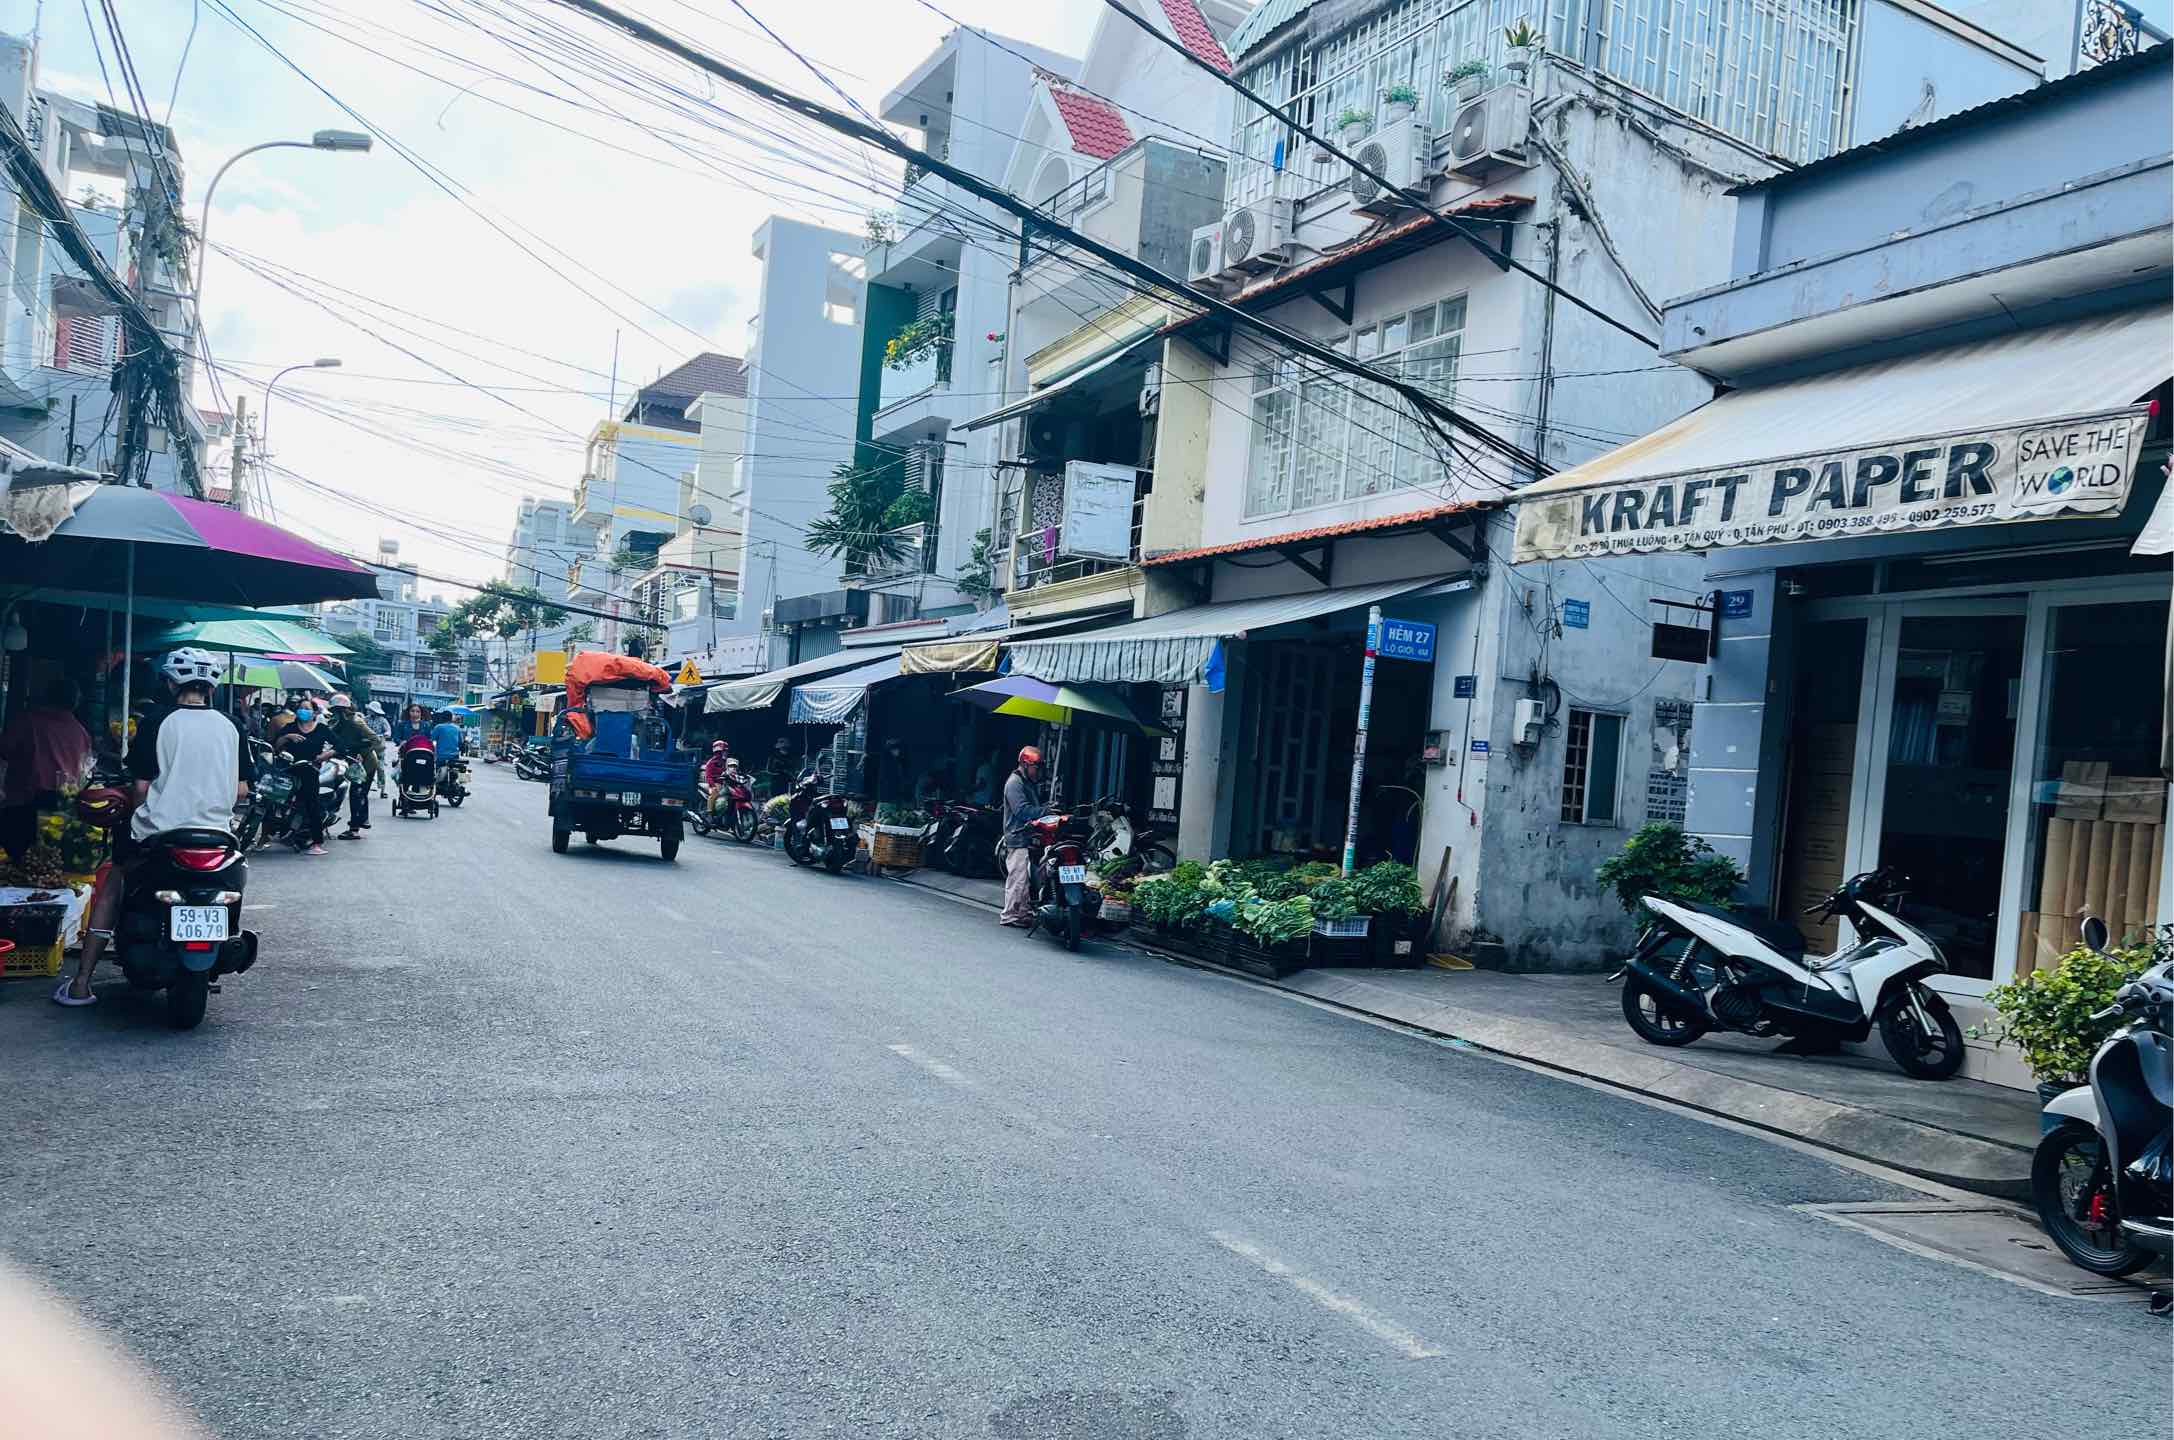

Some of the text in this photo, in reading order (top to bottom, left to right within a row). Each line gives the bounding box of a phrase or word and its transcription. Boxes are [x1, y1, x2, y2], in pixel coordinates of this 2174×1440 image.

[2021, 427, 2126, 462] SAVE THE
[1580, 441, 1999, 536] KRAFT PAPER
[1733, 528, 1744, 540] Q.
[1745, 524, 1763, 538] TÂN
[1909, 504, 1996, 523] 0902.259.573
[1415, 631, 1430, 644] 27
